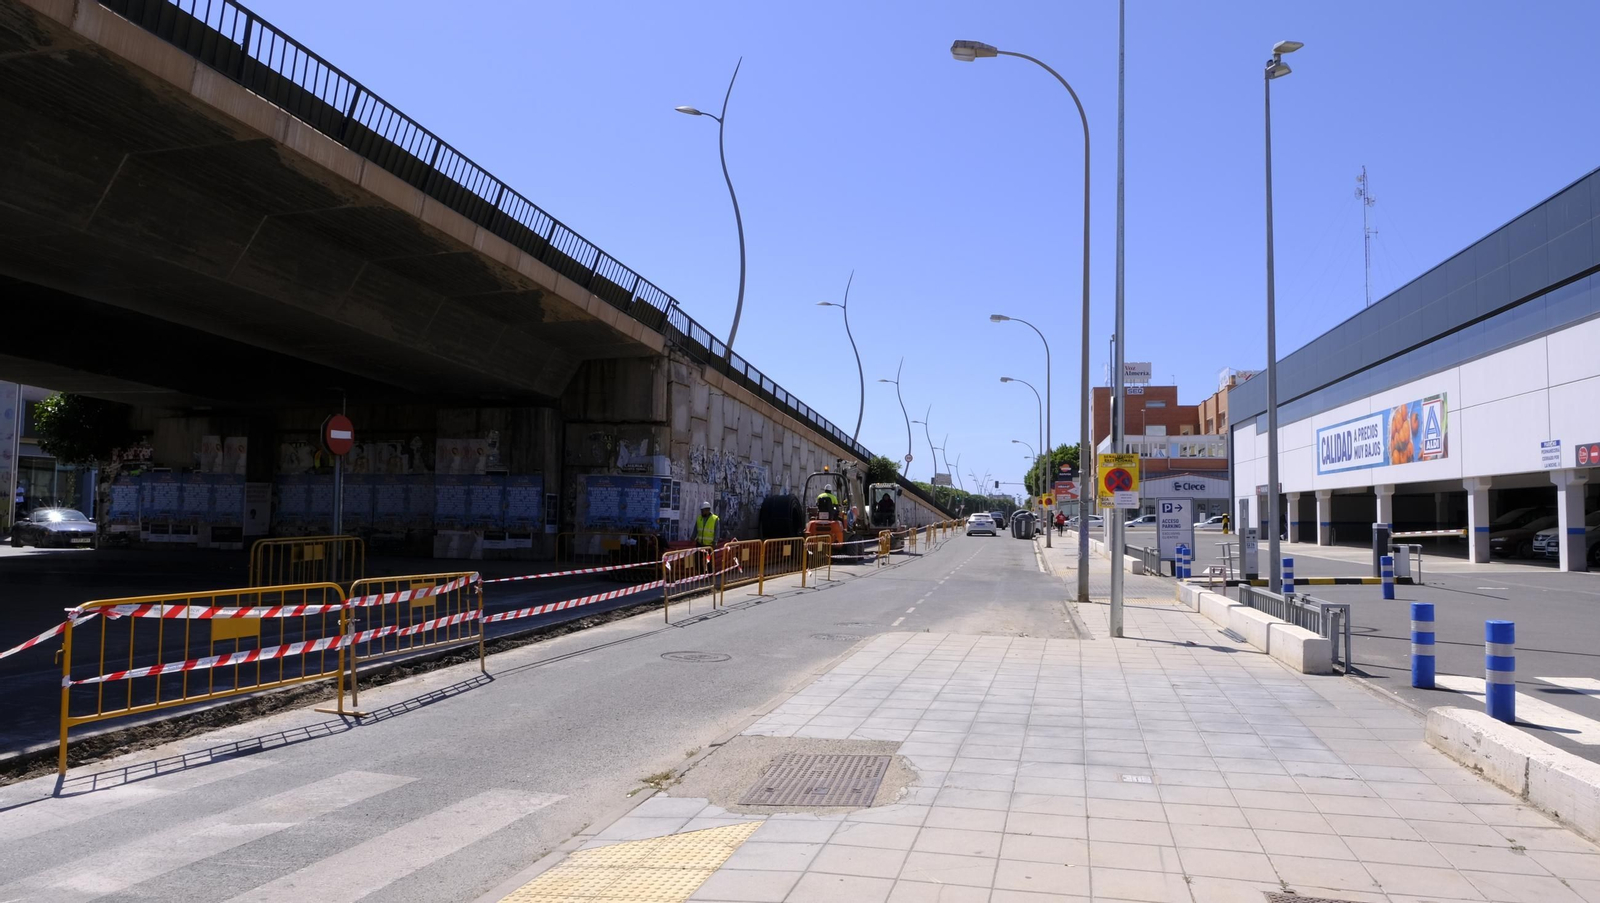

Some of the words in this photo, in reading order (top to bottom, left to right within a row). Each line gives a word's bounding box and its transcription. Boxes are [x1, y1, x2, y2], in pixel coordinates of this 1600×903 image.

[1321, 430, 1353, 466] CALIDAD
[1353, 429, 1358, 443] A
[1358, 423, 1379, 442] PRECIOS
[1353, 444, 1365, 460] MUY
[1364, 441, 1381, 457] BAJOS
[1425, 438, 1441, 450] ALDI
[1183, 482, 1206, 491] Clece
